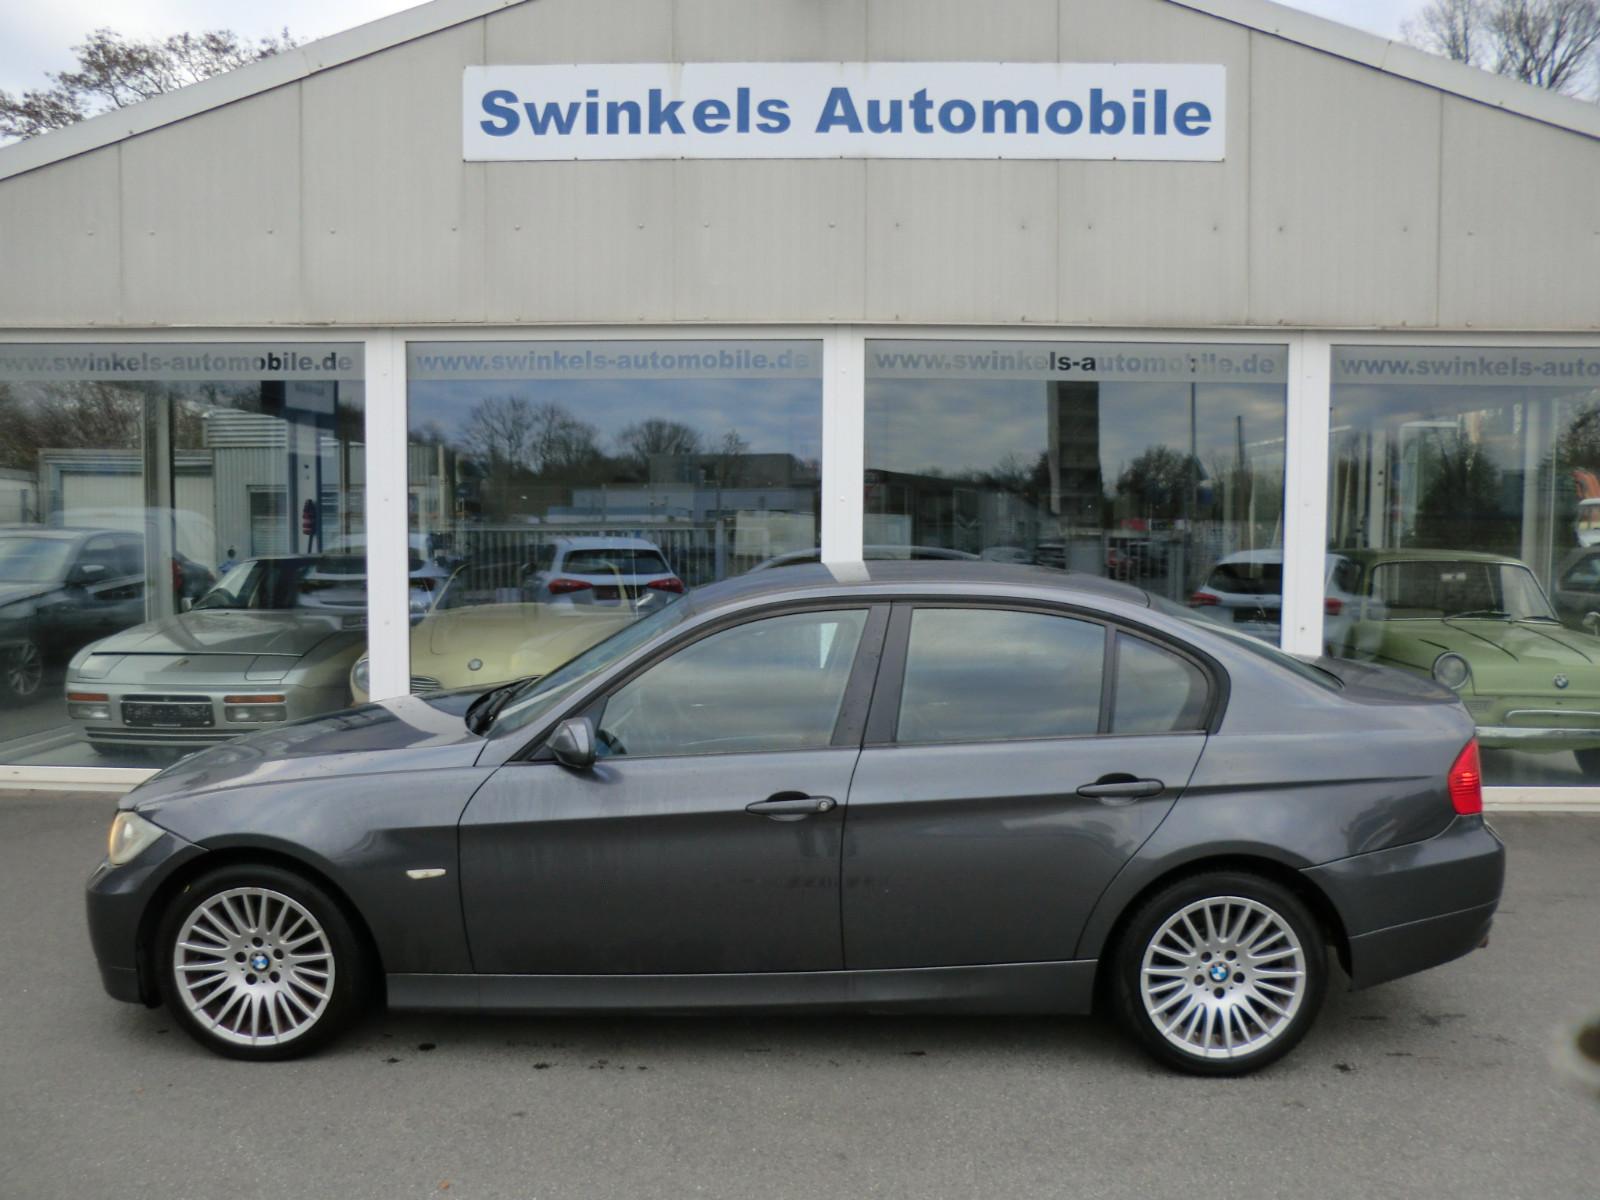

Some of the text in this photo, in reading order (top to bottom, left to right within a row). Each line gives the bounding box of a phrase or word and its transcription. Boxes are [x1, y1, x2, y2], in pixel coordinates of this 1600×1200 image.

[480, 87, 1213, 137] Swinkels Automobile
[0, 352, 352, 372] ww.swinkels-automobile.de
[416, 350, 809, 371] www.swinkels-automobile.de
[874, 351, 1275, 374] www.swinkels-automobile.de
